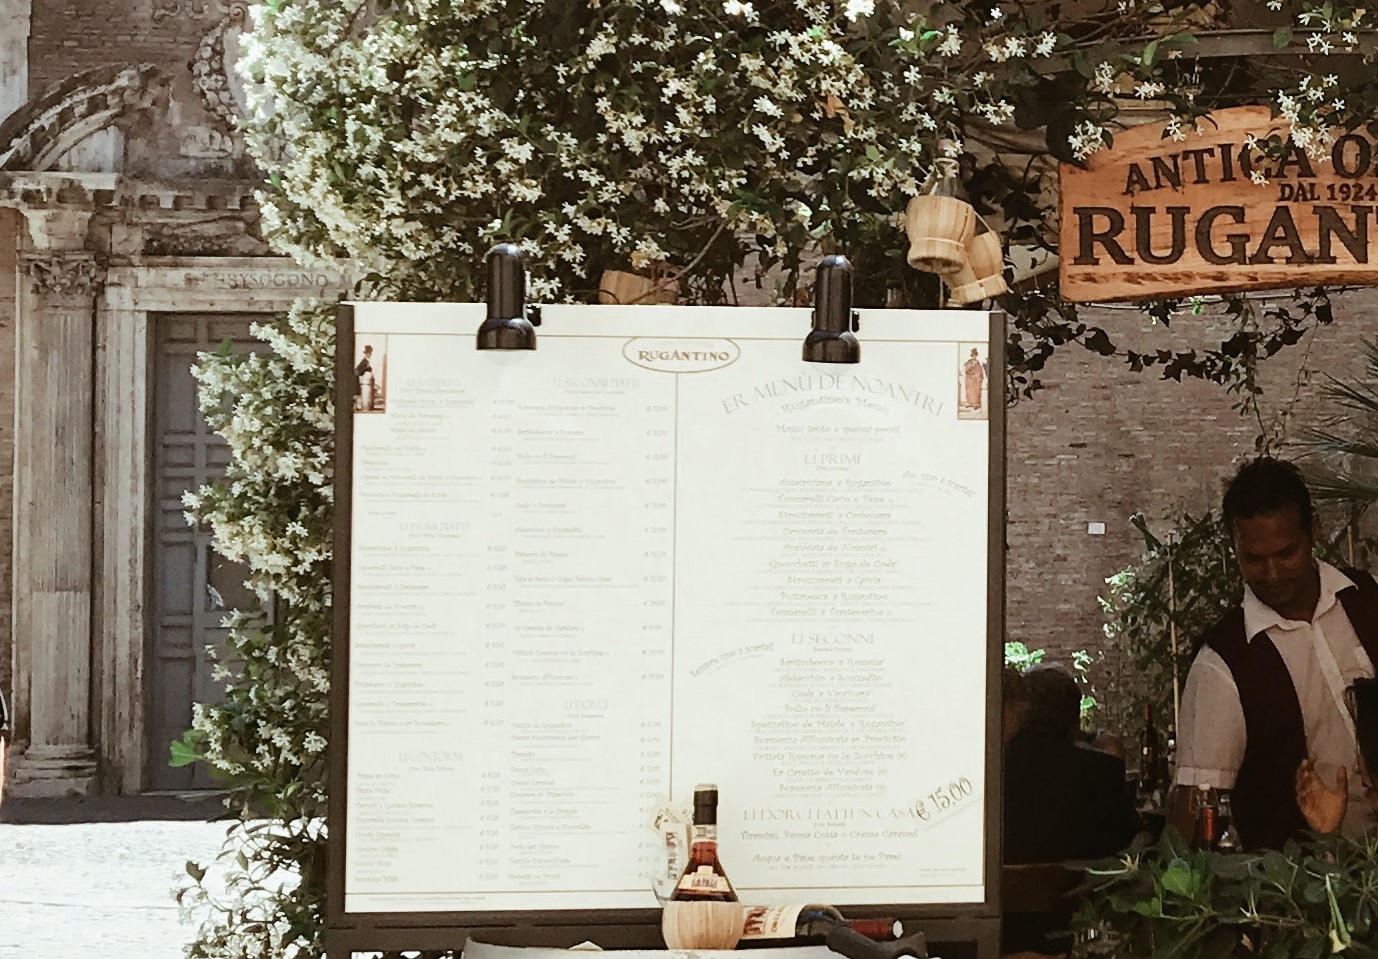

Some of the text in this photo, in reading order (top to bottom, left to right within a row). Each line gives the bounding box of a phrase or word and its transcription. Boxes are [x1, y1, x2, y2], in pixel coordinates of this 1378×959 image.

[1121, 135, 1316, 197] ANTICA
[1278, 182, 1378, 202] DAL 1924
[638, 349, 730, 362] RUGANTINO
[819, 373, 846, 390] DE
[928, 776, 974, 813] 15,00
